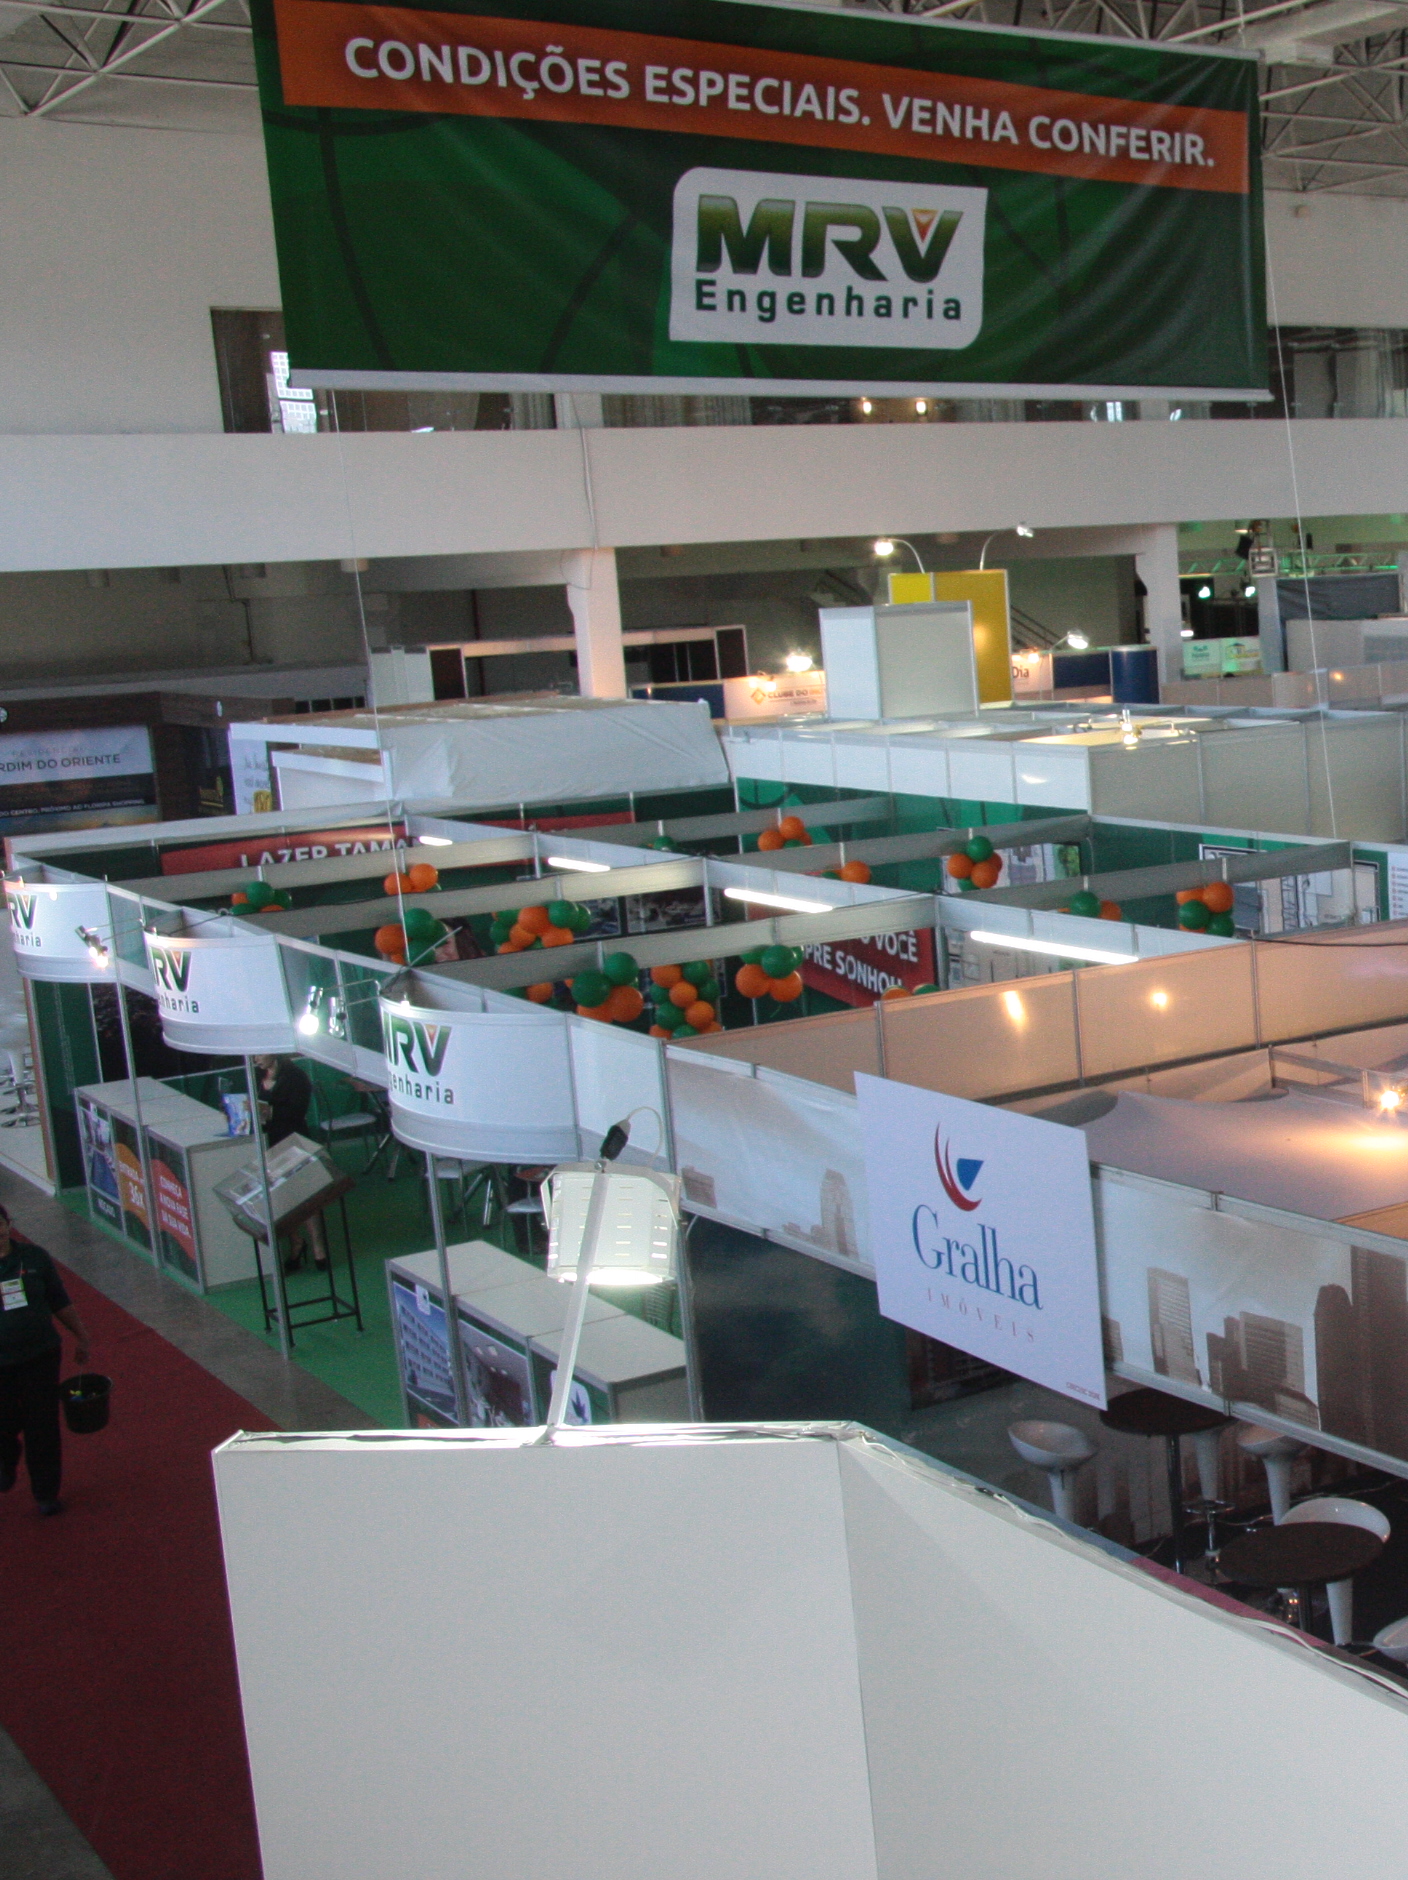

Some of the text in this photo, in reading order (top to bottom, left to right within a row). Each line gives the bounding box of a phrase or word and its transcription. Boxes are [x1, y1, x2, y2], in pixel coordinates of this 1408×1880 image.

[345, 38, 1215, 167] CONDIÇÕES ESPECIAIS. VENHA CONFERIR.
[696, 194, 964, 283] MRV
[695, 279, 962, 322] Engenharia
[37, 757, 58, 771] DO
[61, 753, 121, 768] ORIENTE
[7, 893, 38, 930] RV
[875, 930, 919, 963] VOCÊ
[911, 1204, 1044, 1311] Gralha
[927, 1286, 1036, 1343] IMÓVEIS
